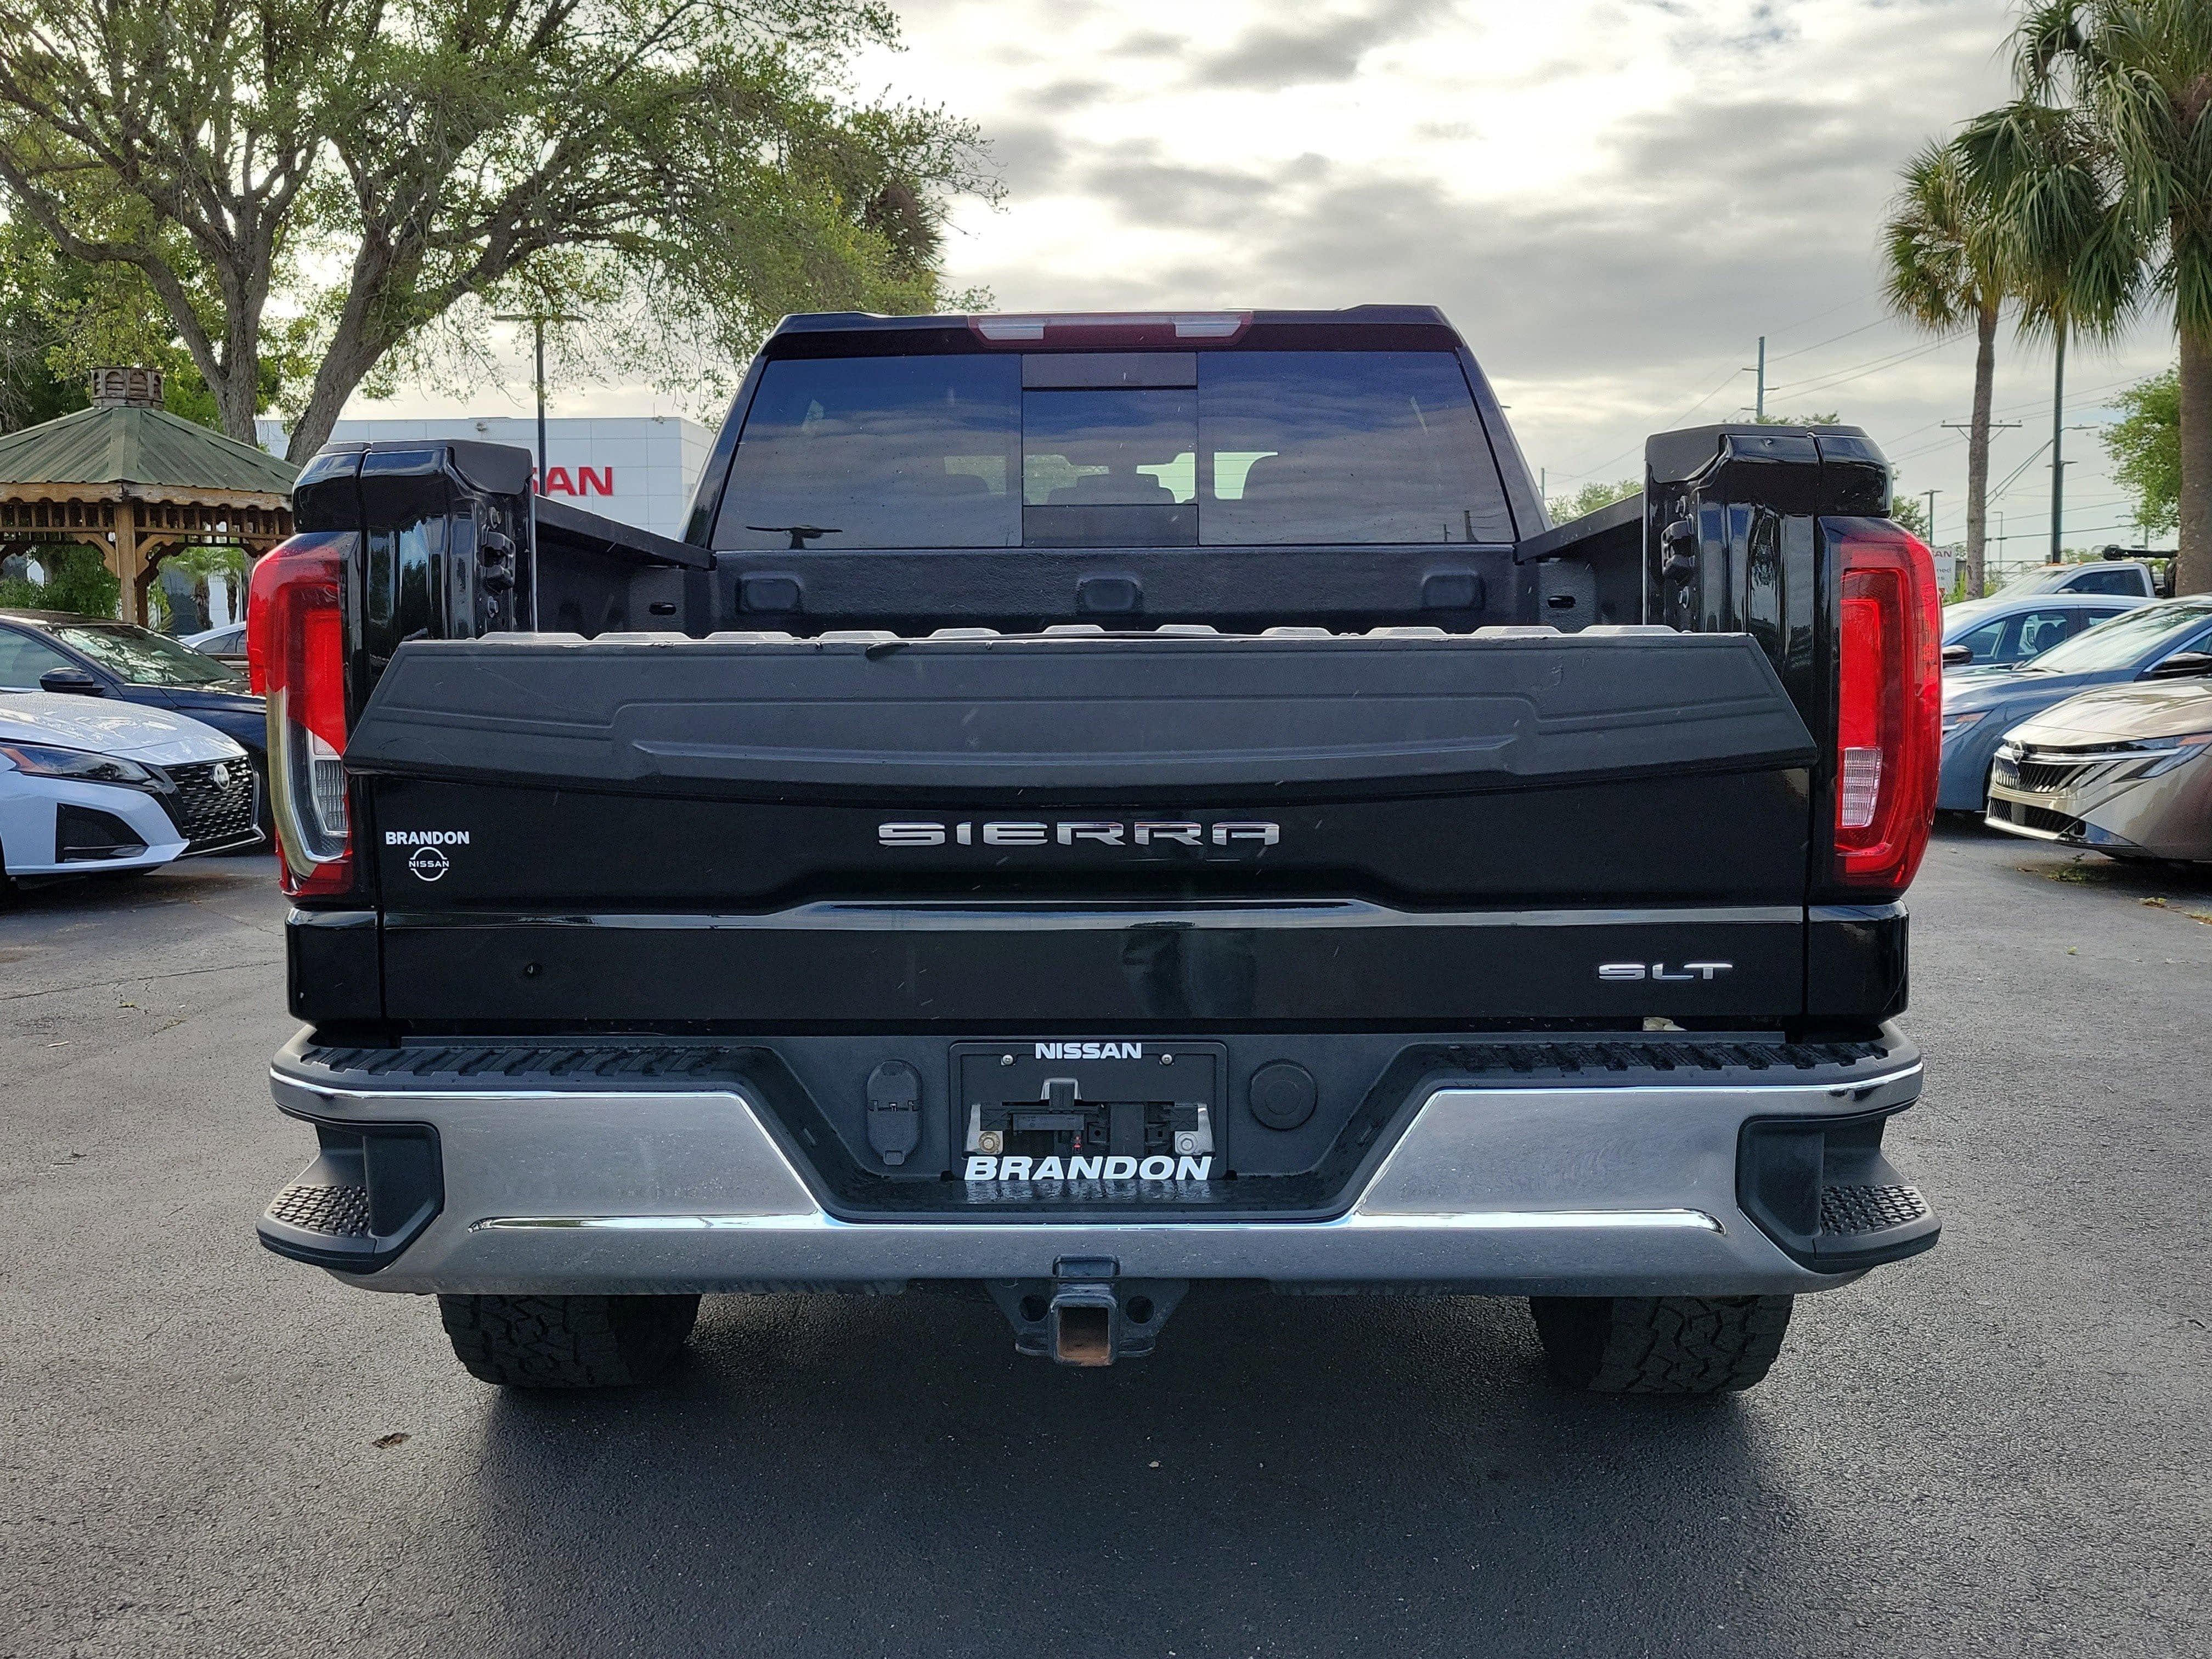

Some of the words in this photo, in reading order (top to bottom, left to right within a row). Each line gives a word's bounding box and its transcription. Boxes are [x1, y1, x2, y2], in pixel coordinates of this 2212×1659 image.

[386, 831, 470, 845] BRANDON
[878, 821, 1280, 846] SIERRA
[1599, 963, 1733, 980] SLT
[1035, 1042, 1142, 1059] NISSAN
[964, 1155, 1212, 1181] BRANDON
